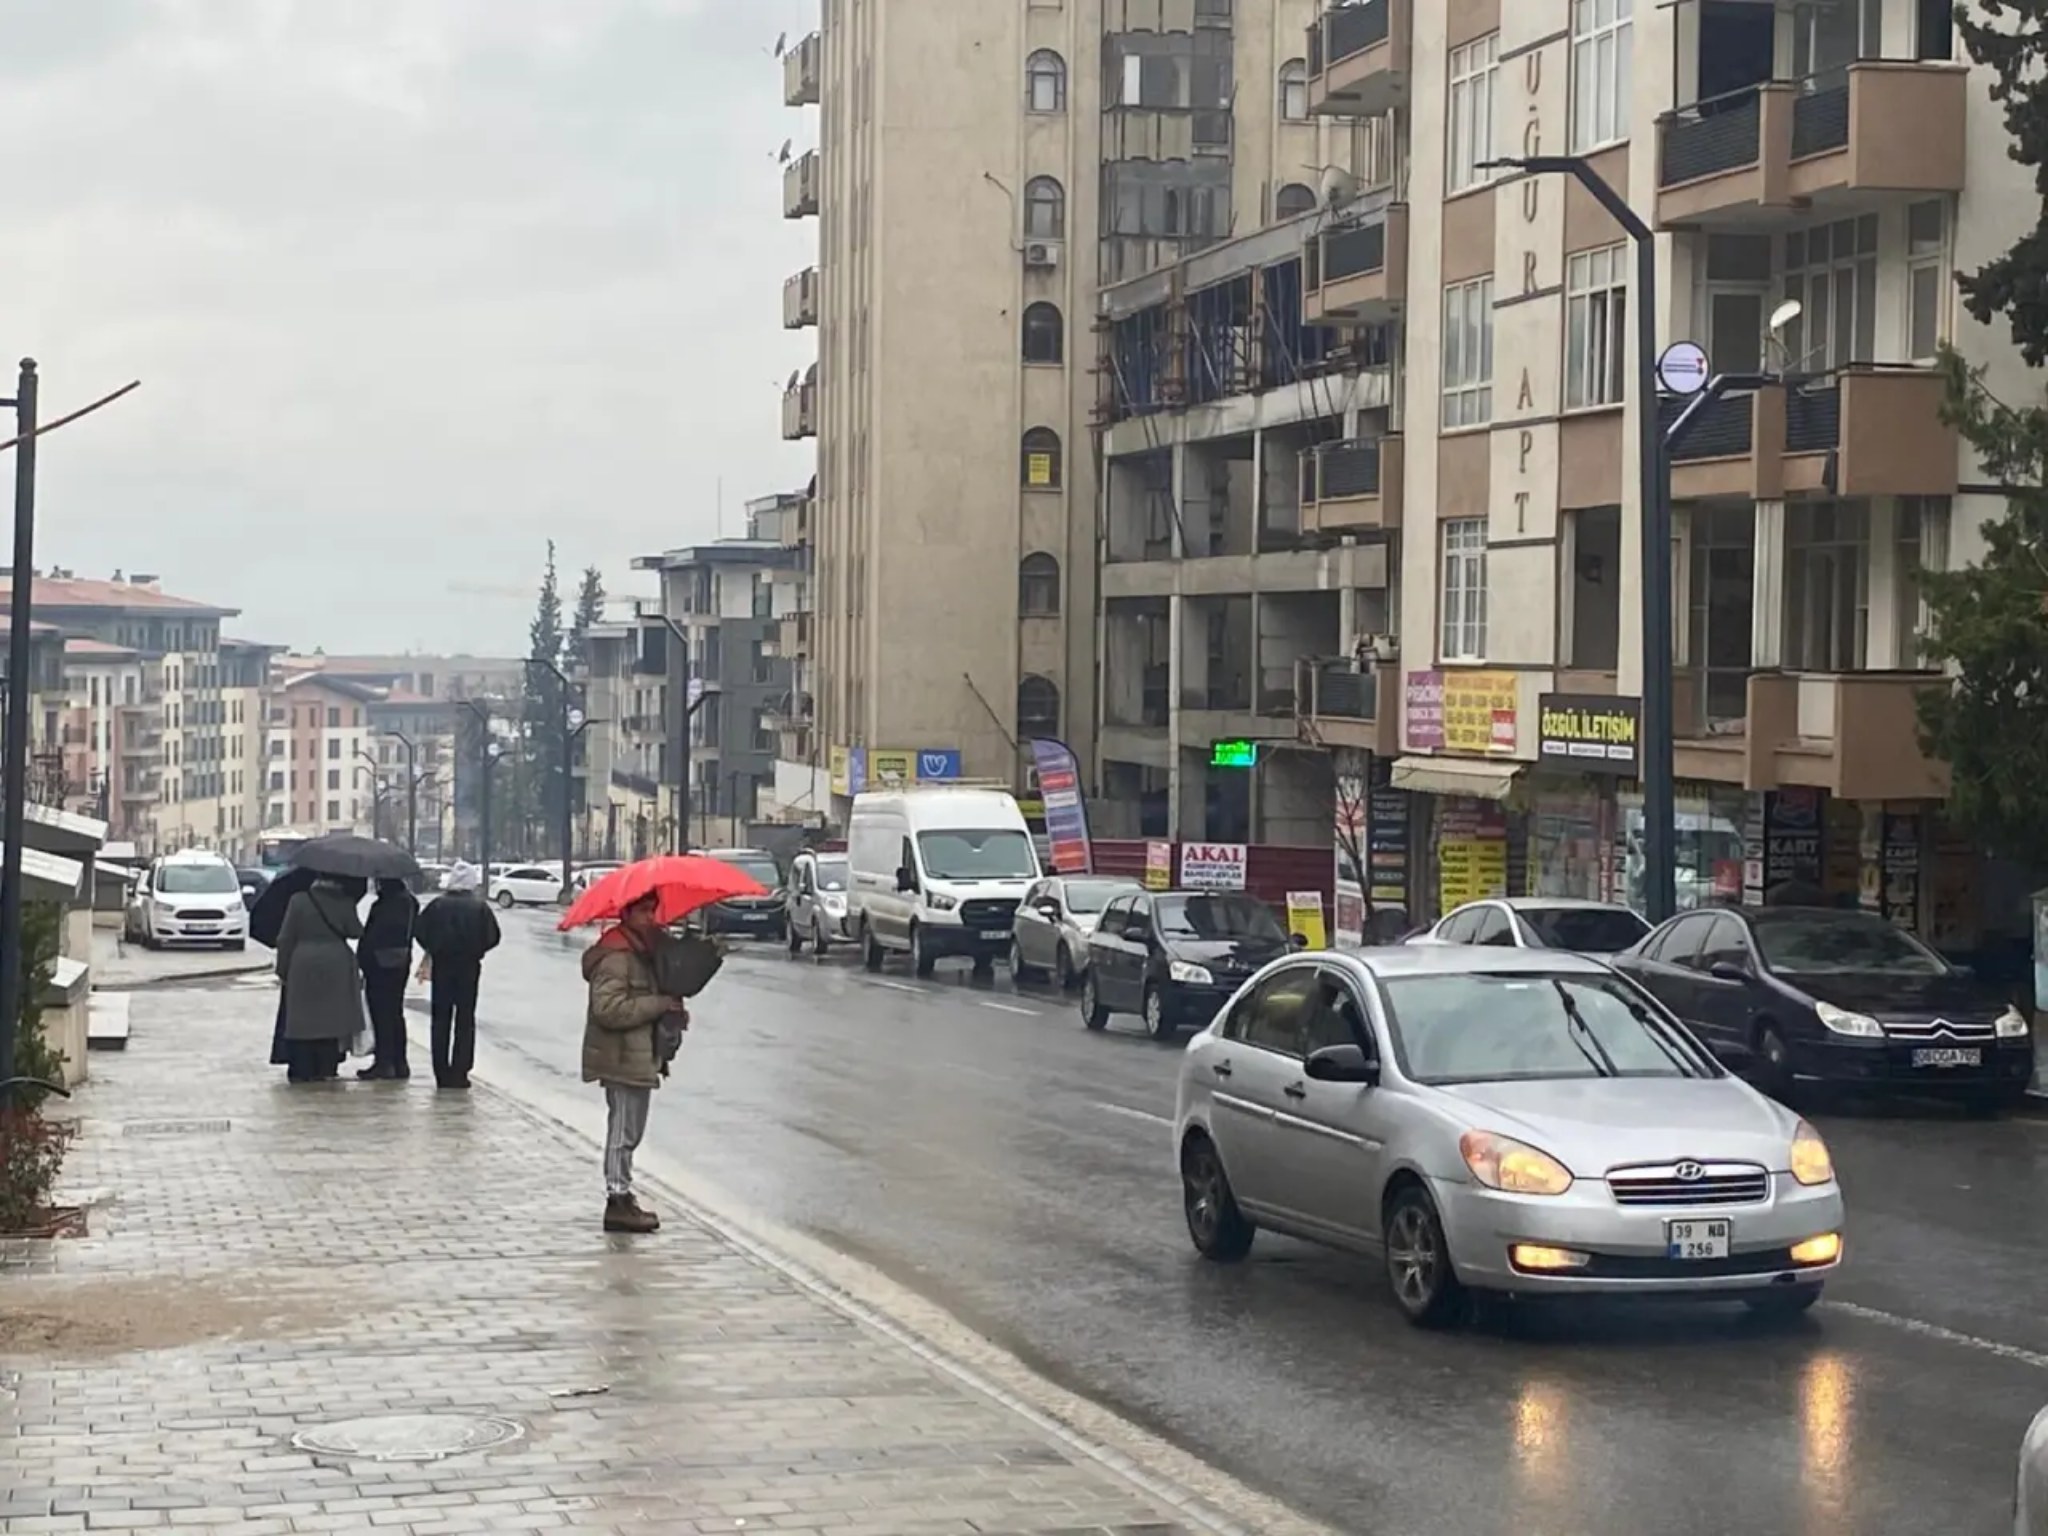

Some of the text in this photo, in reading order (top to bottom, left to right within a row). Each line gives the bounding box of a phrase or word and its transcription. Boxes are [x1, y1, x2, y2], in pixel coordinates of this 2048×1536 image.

[1514, 366, 1533, 533] APT
[1542, 707, 1581, 738] ÖZGÜL
[1582, 709, 1635, 744] İLETİŞİM
[1185, 846, 1244, 862] AKAL
[1769, 838, 1818, 855] KART
[1676, 1224, 1692, 1239] 39
